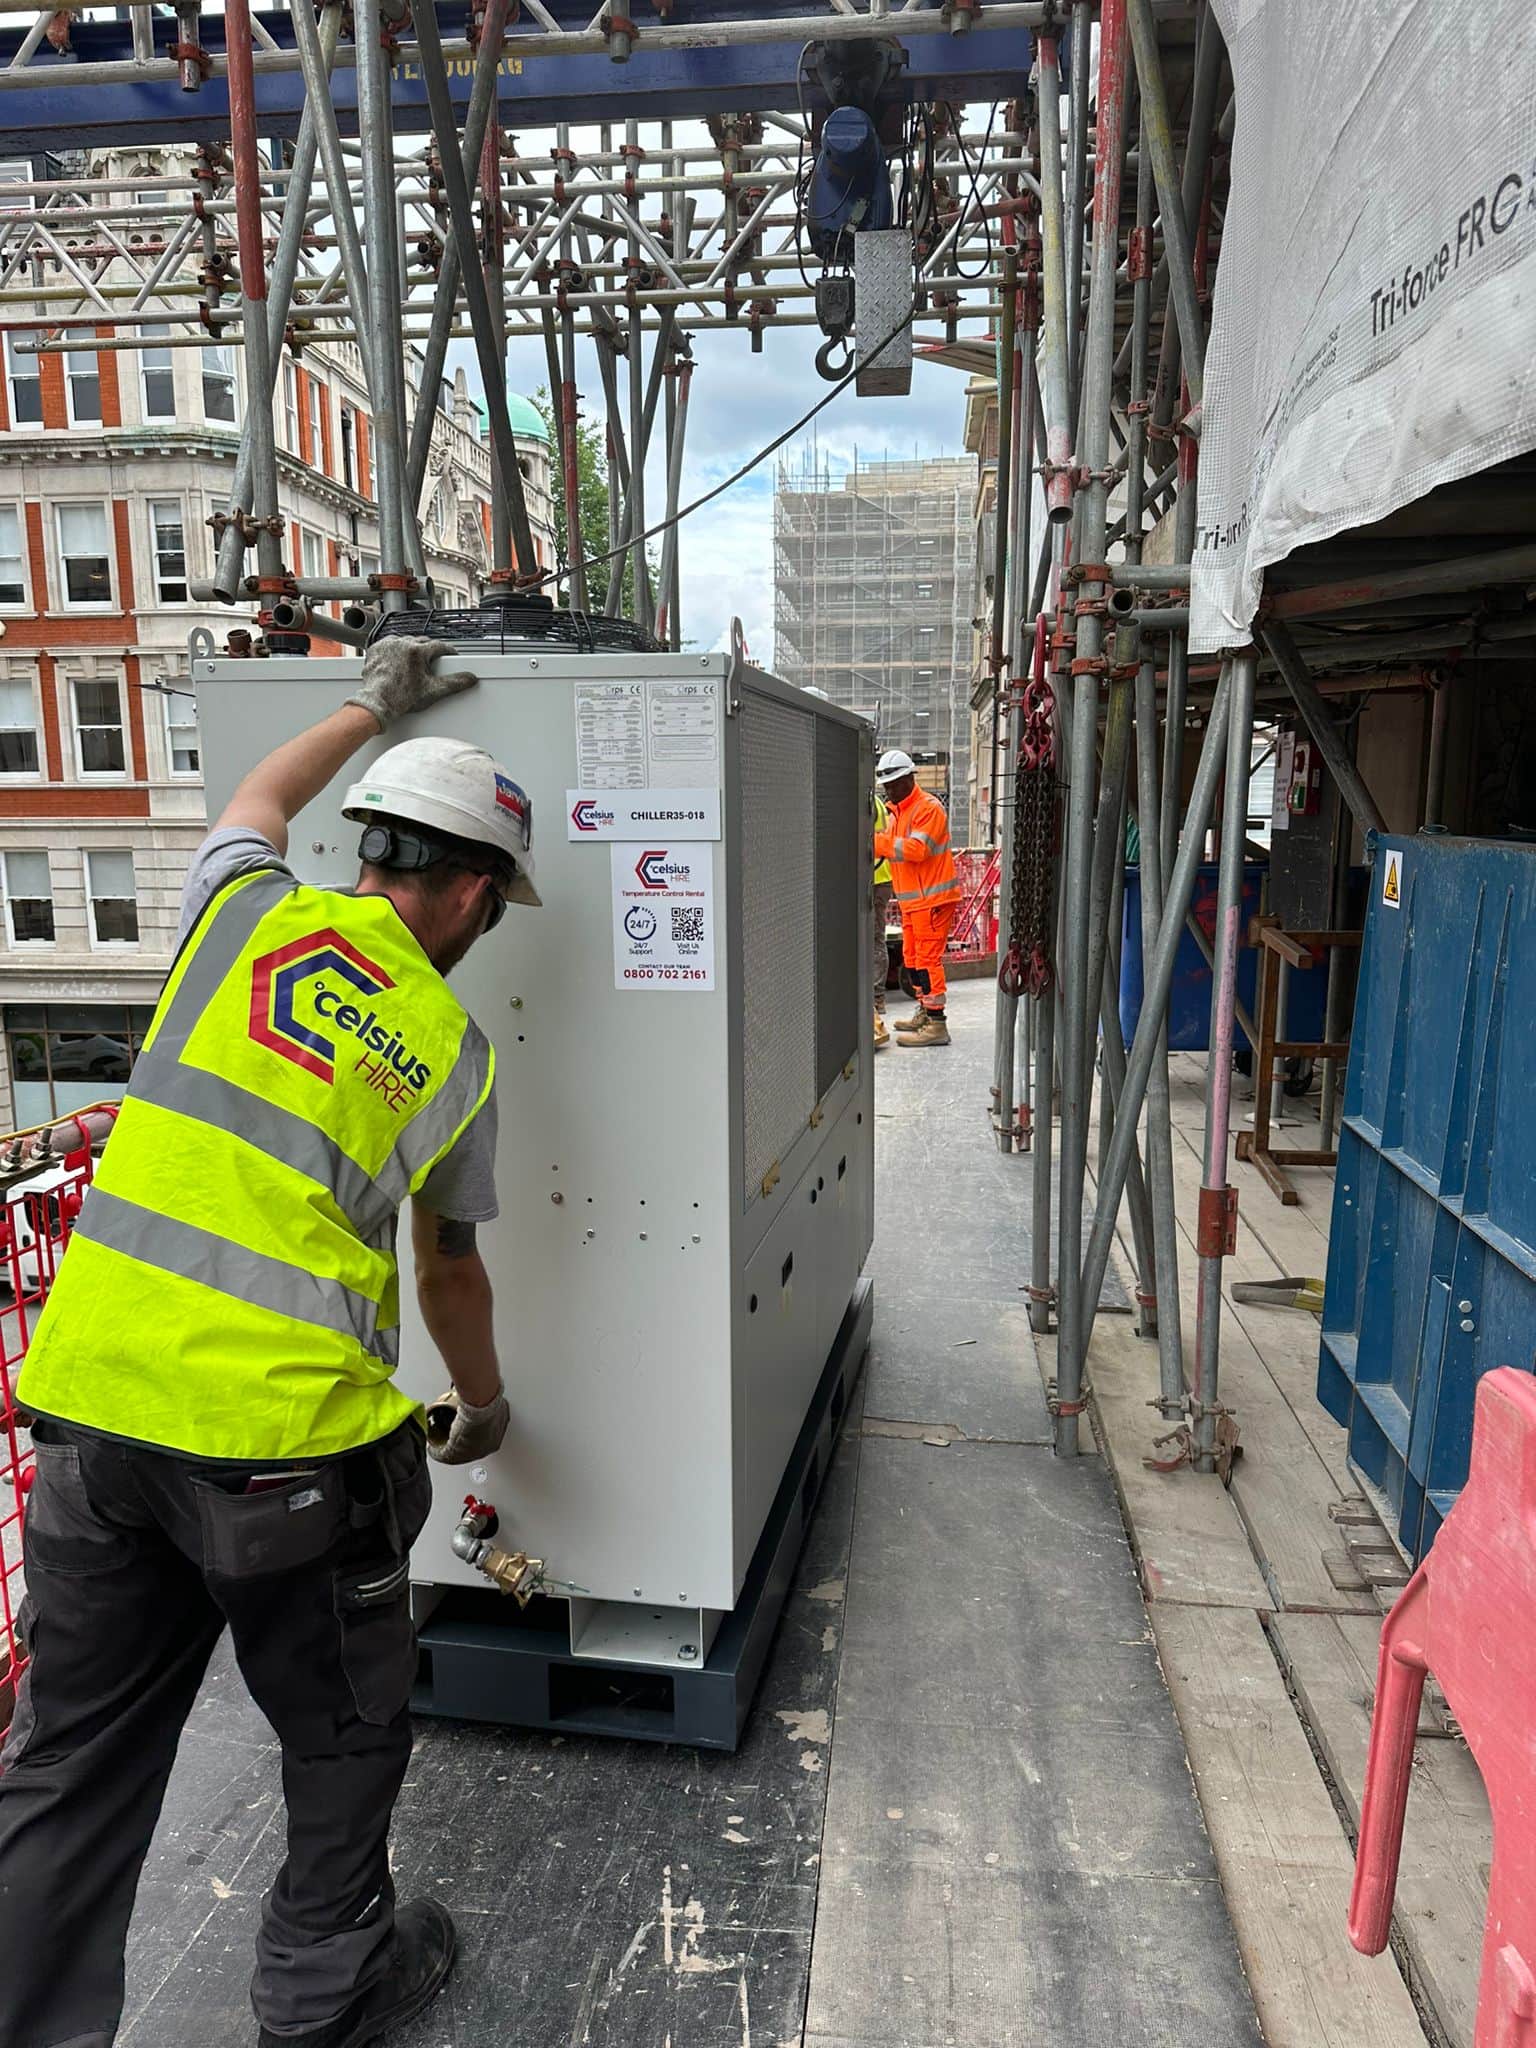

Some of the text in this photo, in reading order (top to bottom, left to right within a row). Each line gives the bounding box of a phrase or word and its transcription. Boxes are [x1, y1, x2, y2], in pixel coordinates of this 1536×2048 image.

[1370, 243, 1449, 337] Tri-force
[630, 811, 705, 821] CHILLER35-018
[622, 890, 660, 898] Temperature
[630, 919, 651, 929] 24/7
[623, 969, 706, 980] 0800 702 2161
[353, 1051, 417, 1114] HIRE
